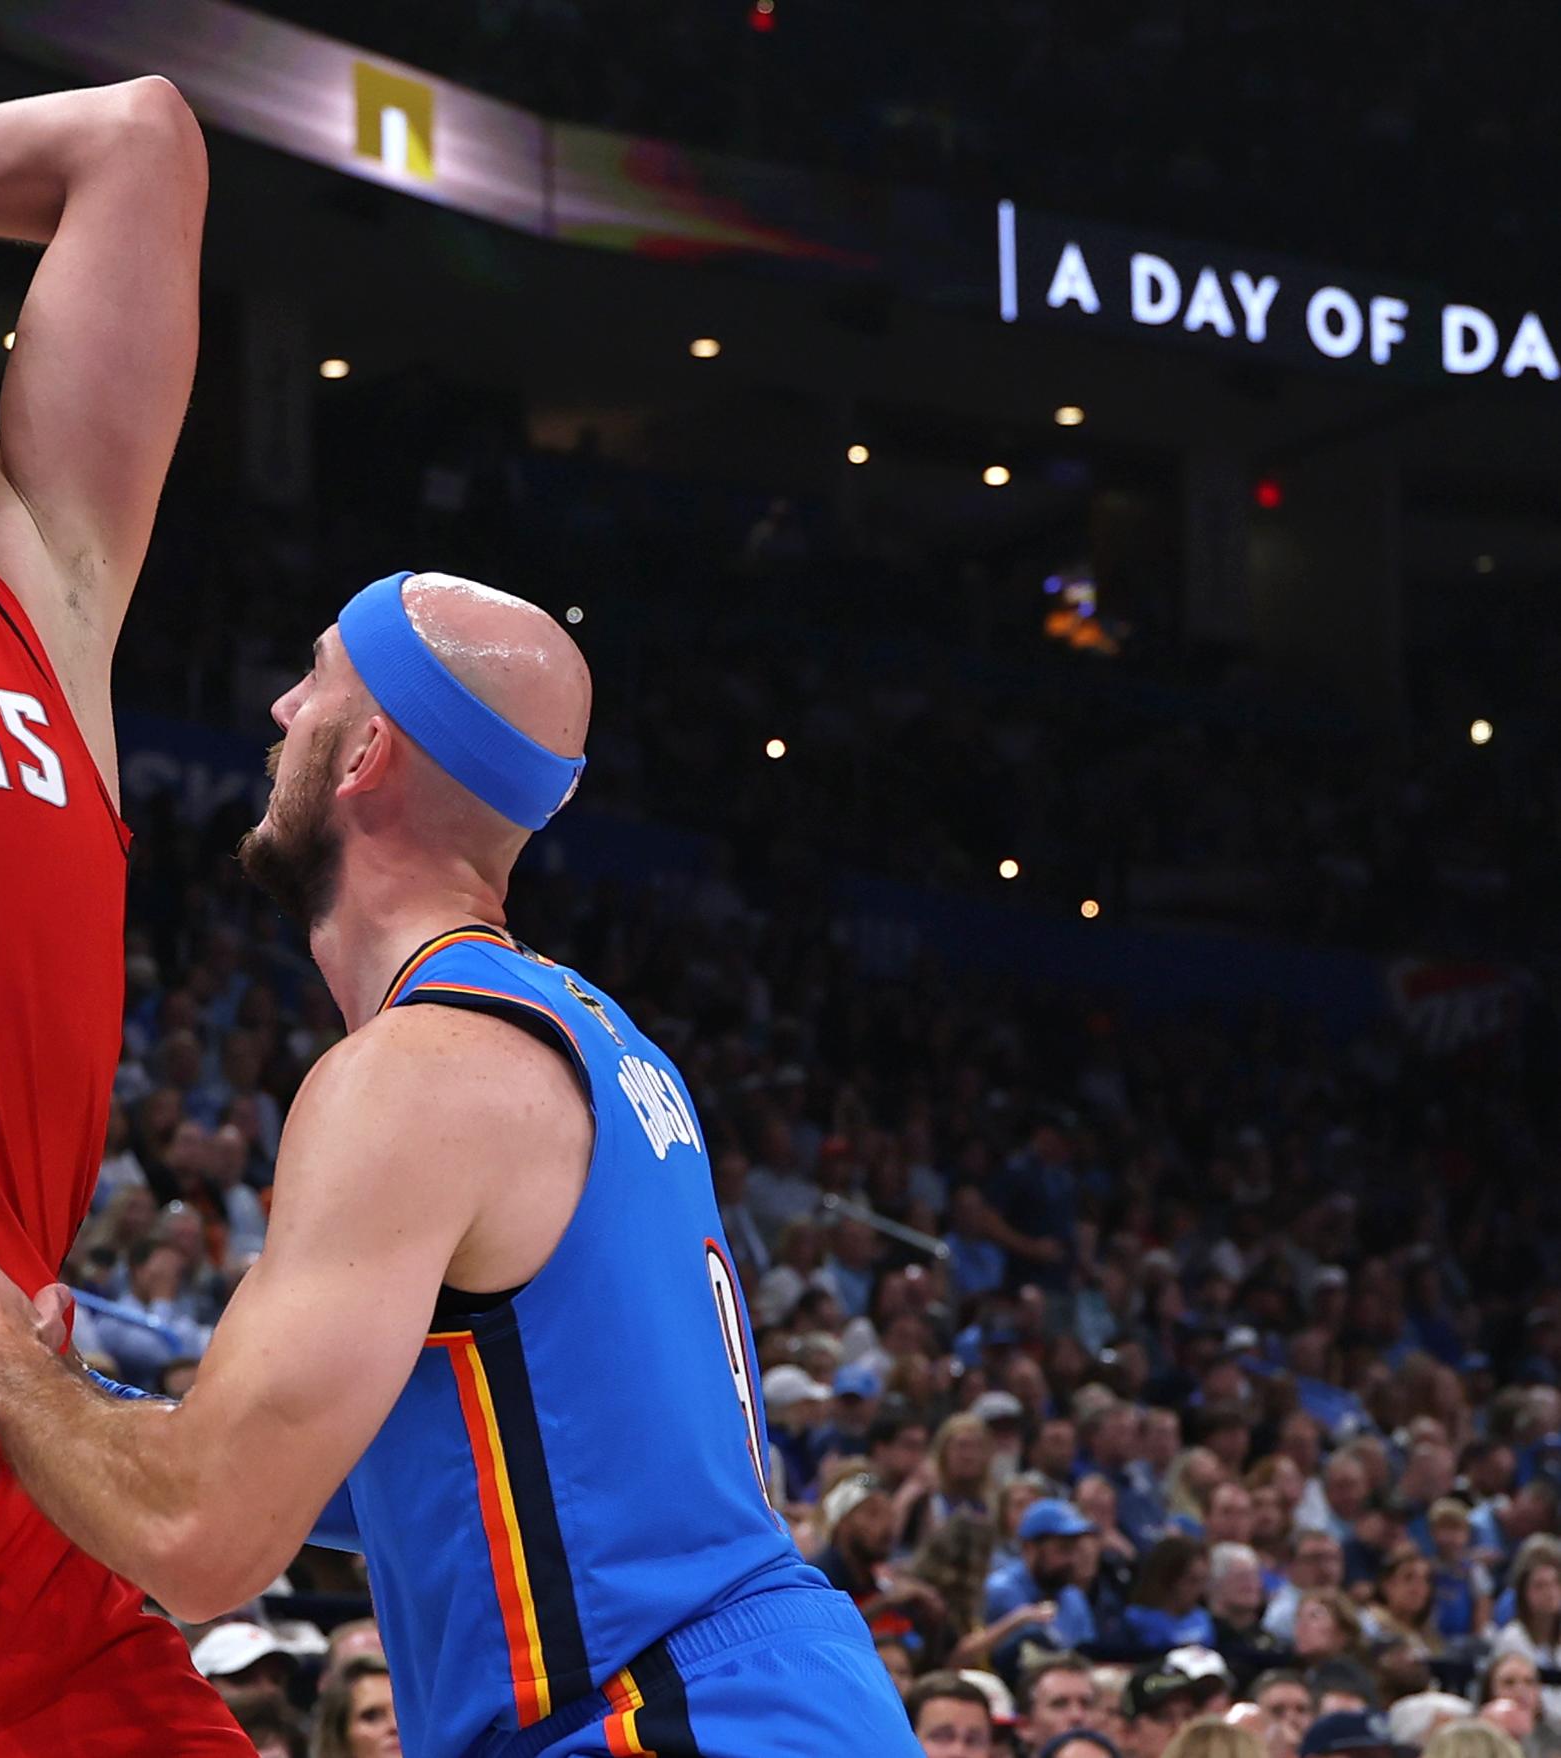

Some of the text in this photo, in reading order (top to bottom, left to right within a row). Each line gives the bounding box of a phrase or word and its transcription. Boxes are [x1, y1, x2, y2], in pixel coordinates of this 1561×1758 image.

[1046, 240, 1561, 382] A DAY OF DA
